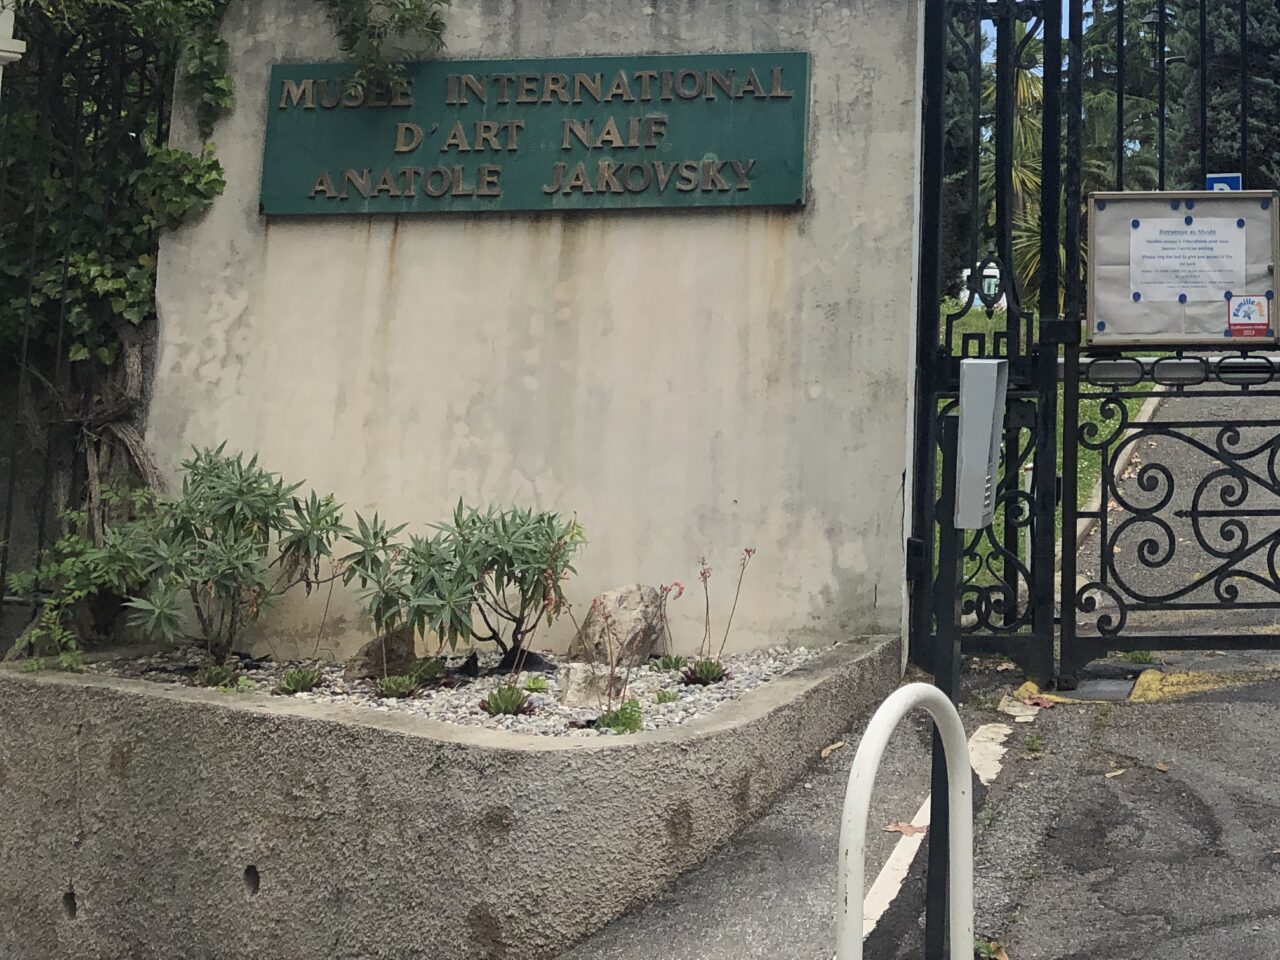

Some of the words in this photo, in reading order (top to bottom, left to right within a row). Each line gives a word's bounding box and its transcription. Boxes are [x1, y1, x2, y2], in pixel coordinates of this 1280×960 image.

[446, 67, 795, 106] INTERNATIONAL
[394, 118, 525, 153] D'ART
[561, 114, 669, 150] NAIF
[308, 164, 501, 199] ANATOLE
[542, 158, 757, 195] JAKOVSKY
[1232, 297, 1256, 318] Famille
